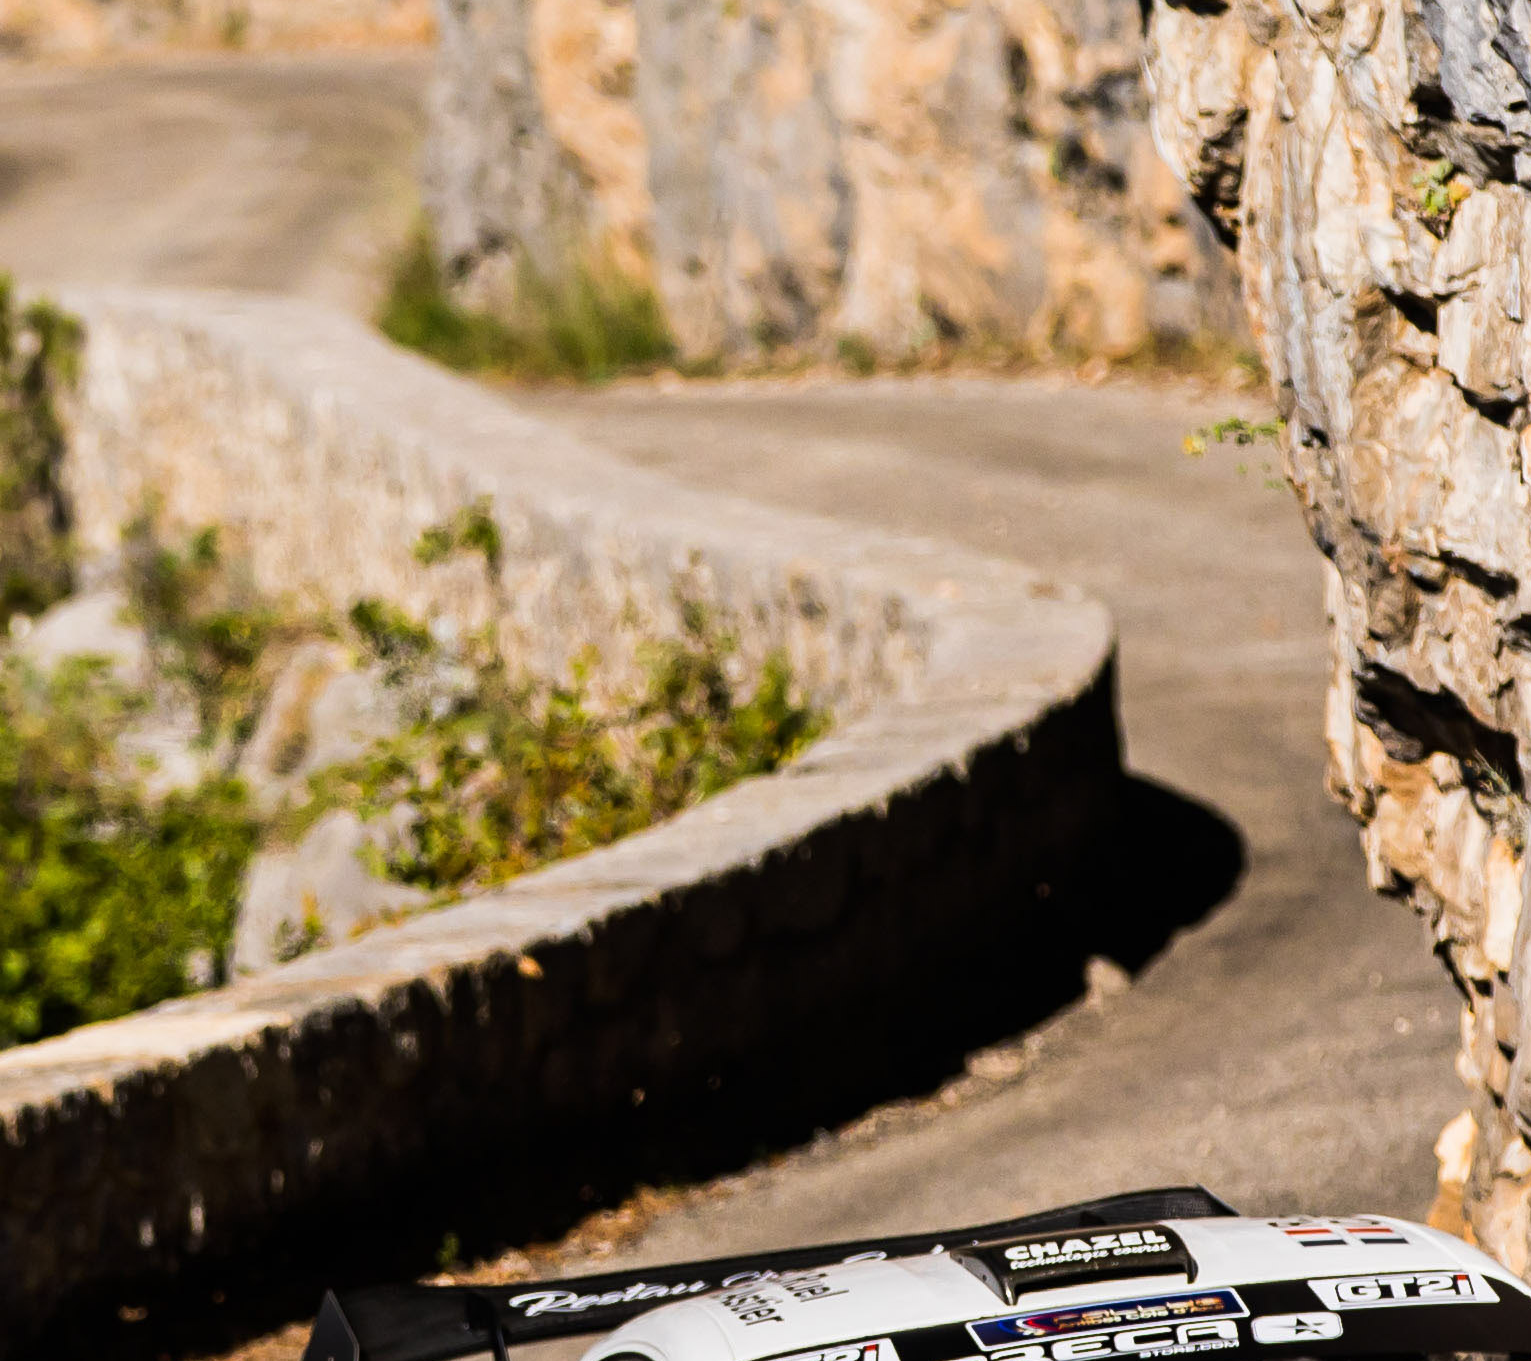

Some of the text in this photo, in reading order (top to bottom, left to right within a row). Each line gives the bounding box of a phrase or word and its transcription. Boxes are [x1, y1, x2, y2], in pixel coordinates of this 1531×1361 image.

[1005, 1230, 1166, 1260] CHAZEL
[1335, 1274, 1475, 1302] GT2i
[1139, 1340, 1240, 1359] STORE.COM
